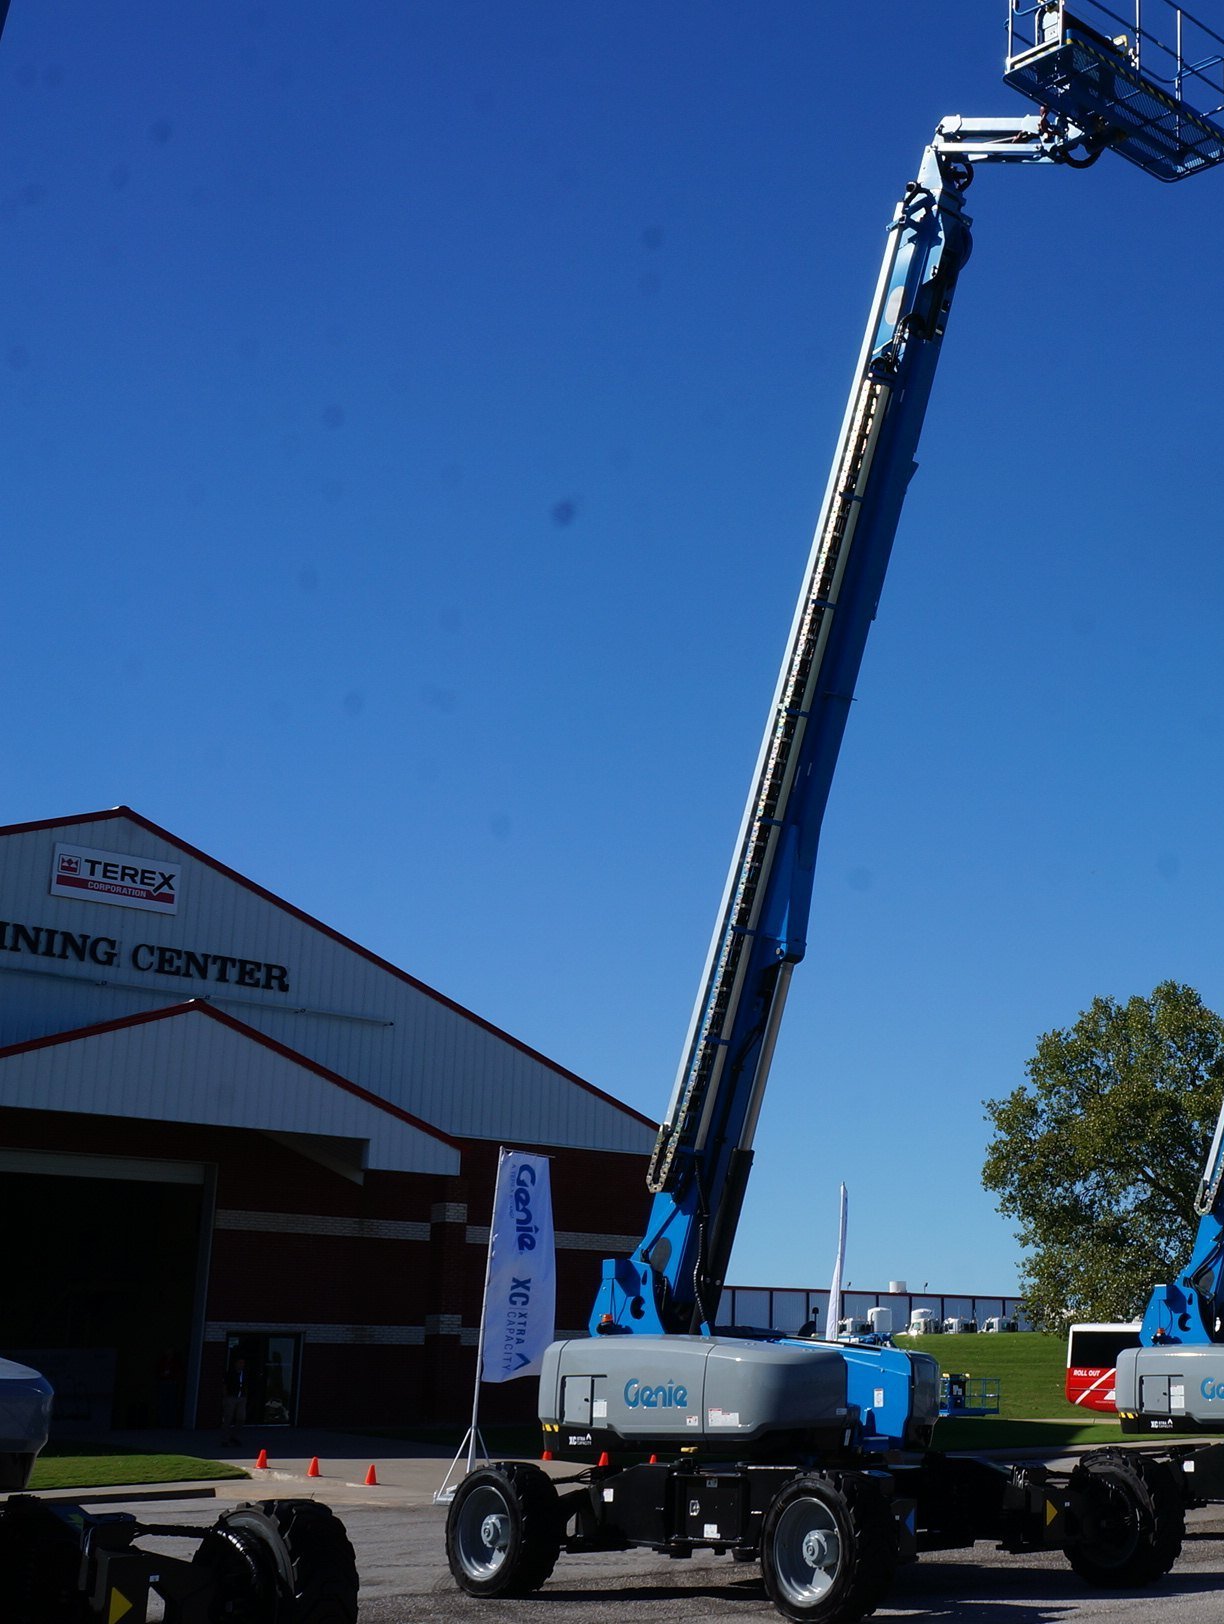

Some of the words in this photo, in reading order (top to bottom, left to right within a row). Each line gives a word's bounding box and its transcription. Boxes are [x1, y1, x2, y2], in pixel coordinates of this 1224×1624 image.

[84, 858, 176, 896] TEREX
[88, 880, 147, 898] CORPORATION
[131, 943, 290, 993] CENTER
[514, 1164, 539, 1251] Genie
[508, 1277, 532, 1306] XC
[502, 1311, 517, 1371] CAPACITY
[515, 1311, 528, 1345] XTRA
[1073, 1369, 1087, 1377] ROLL
[1088, 1369, 1101, 1377] OUT
[623, 1377, 688, 1408] Genie
